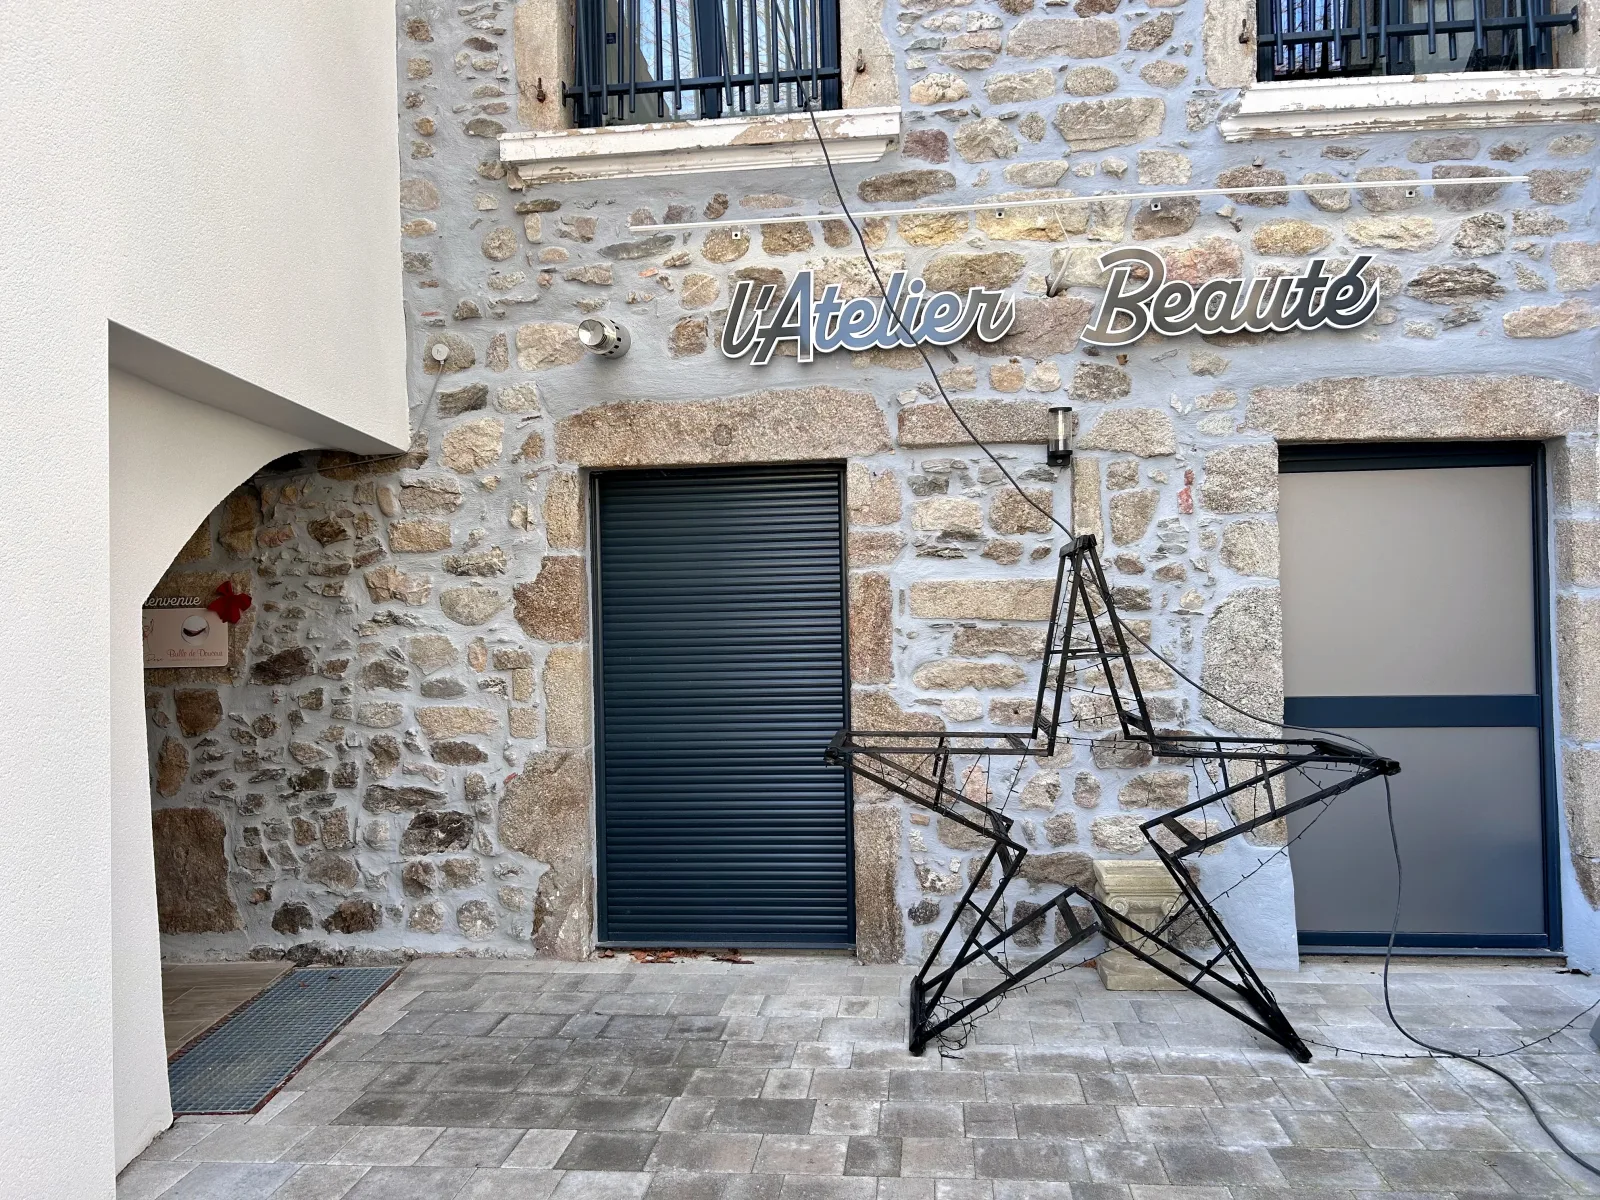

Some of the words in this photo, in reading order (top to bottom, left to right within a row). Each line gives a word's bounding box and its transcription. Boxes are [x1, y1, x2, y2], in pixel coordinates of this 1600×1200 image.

[720, 269, 1017, 366] l'Atelier
[1080, 245, 1380, 347] Beauté
[167, 649, 187, 657] Bulle
[188, 649, 196, 657] de
